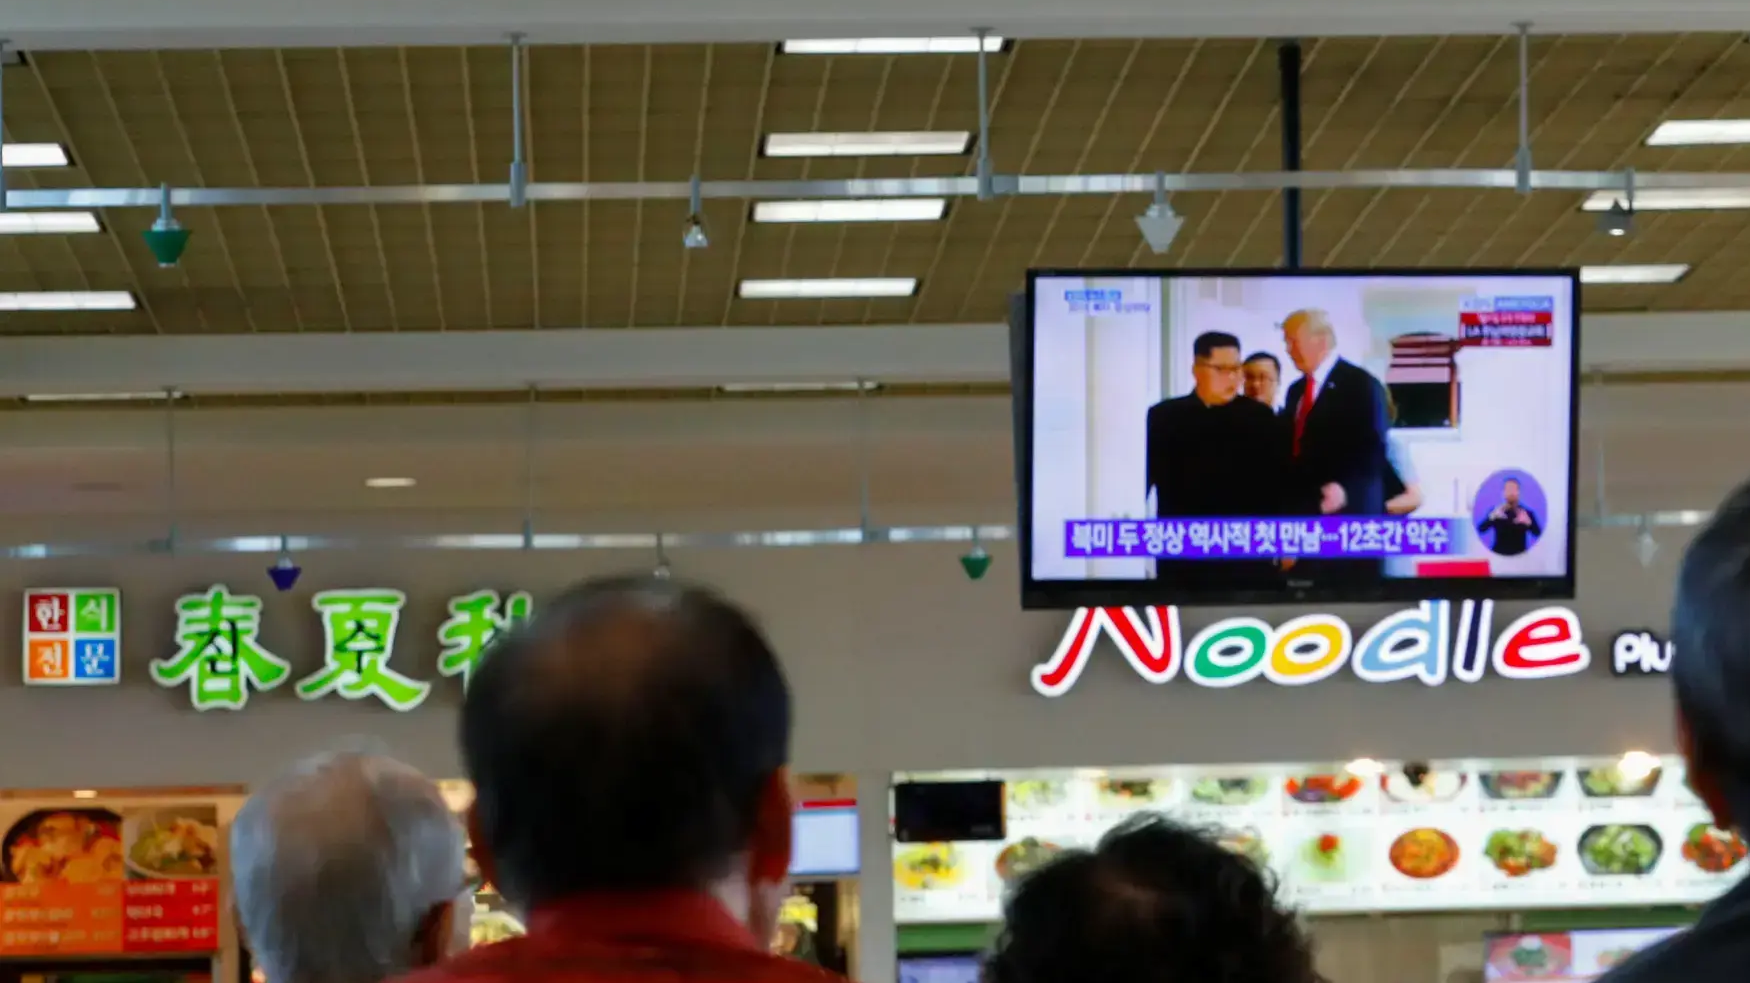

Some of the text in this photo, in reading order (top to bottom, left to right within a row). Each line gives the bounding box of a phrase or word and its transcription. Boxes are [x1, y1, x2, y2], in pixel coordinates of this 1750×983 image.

[1071, 521, 1113, 554] 북미
[1117, 522, 1140, 554] 두
[1142, 521, 1185, 555] 정상
[1188, 521, 1251, 554] 역사적
[1254, 520, 1279, 554] 첫
[1406, 520, 1448, 552] 악수
[1030, 599, 1676, 698] Noodle Plu
